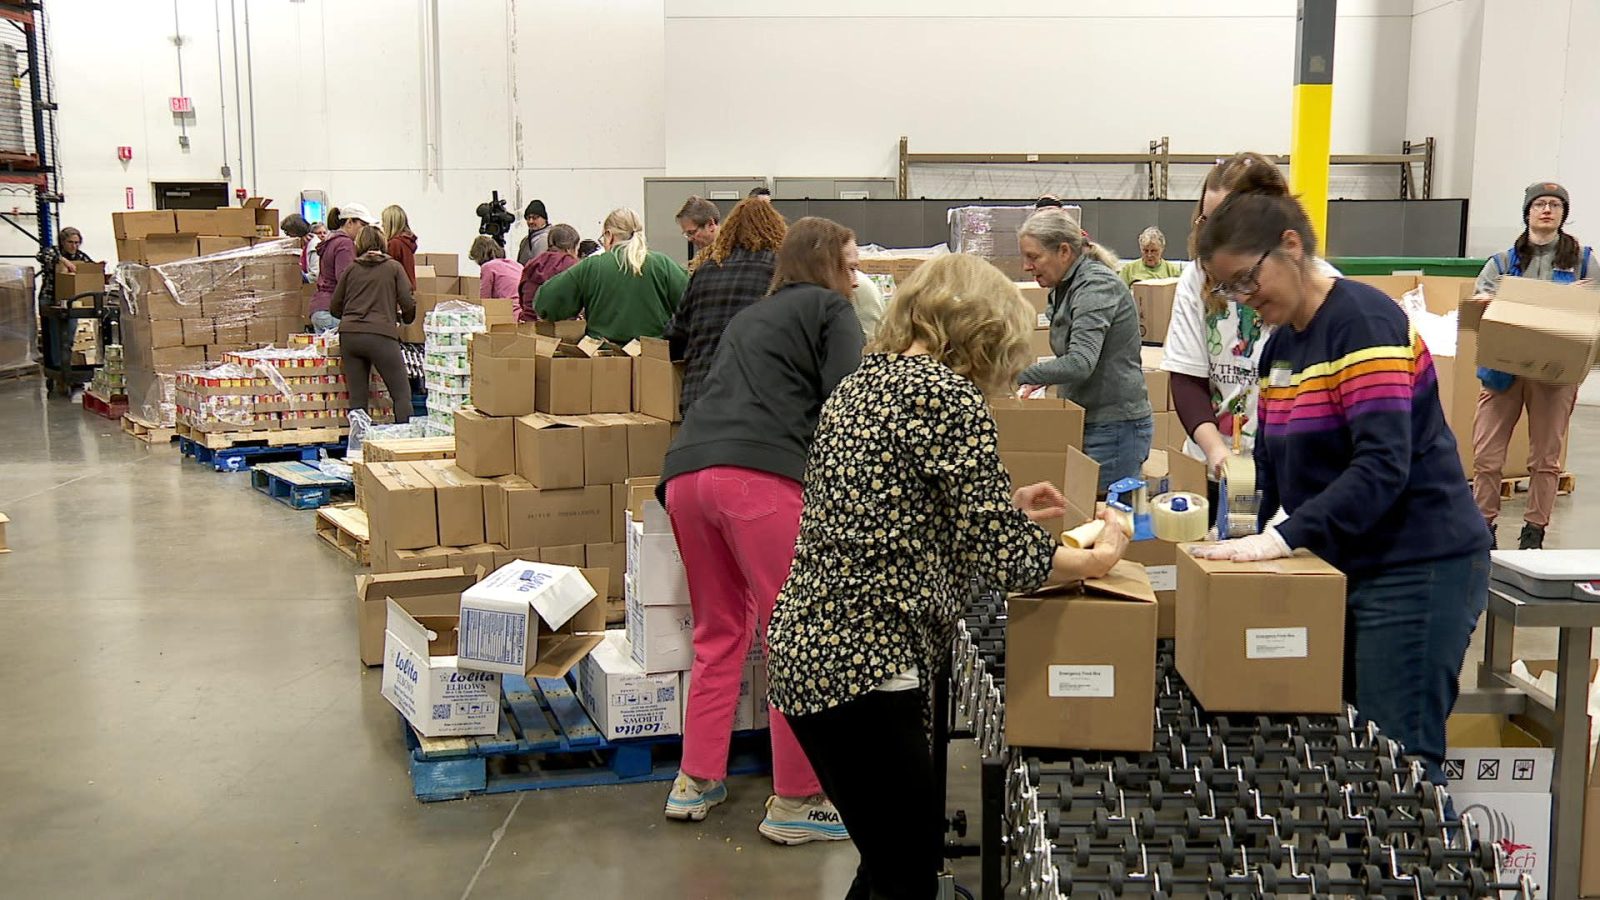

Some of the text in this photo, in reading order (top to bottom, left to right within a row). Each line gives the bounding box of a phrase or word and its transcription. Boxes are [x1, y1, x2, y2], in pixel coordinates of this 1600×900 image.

[395, 651, 418, 684] Lolita
[450, 671, 495, 683] Lolita
[446, 683, 486, 691] ELBOWS
[623, 715, 664, 724] ELBOWS
[615, 722, 660, 735] Lolita
[807, 810, 840, 823] HOKA
